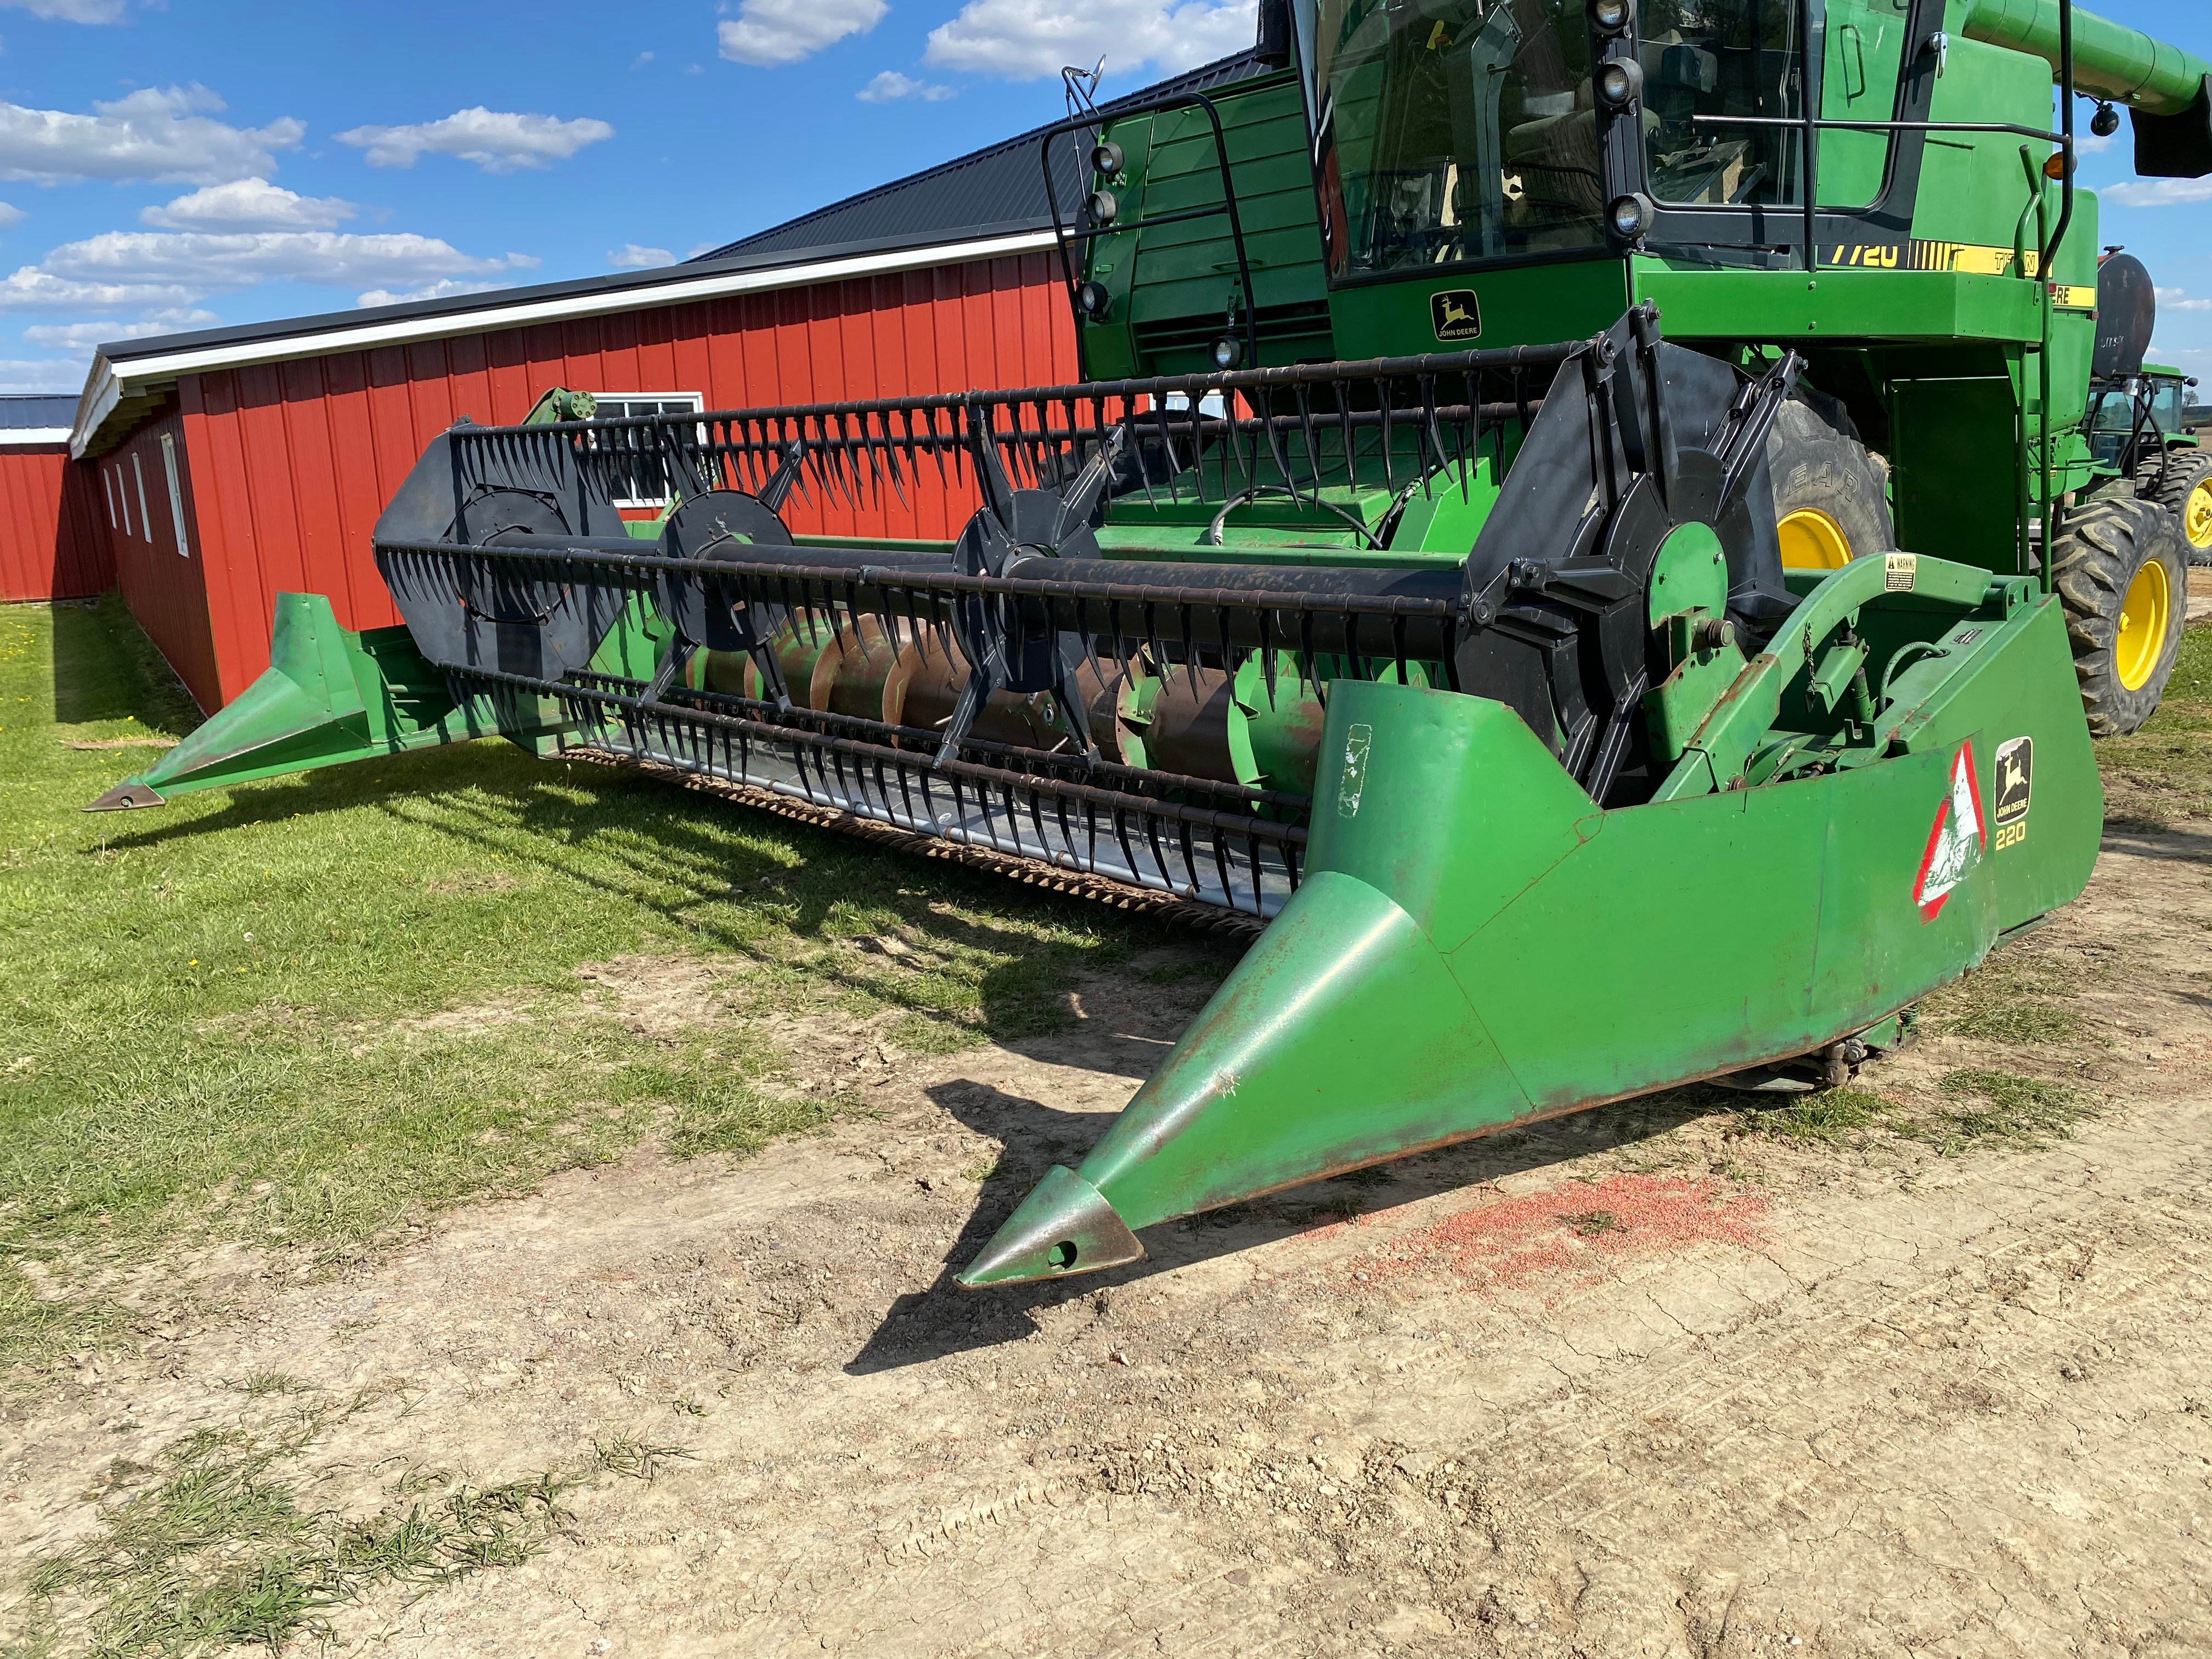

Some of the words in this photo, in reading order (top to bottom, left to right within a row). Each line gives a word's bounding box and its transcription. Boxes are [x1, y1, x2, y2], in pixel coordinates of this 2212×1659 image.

[1457, 327, 1478, 335] DEERE
[1996, 805, 2011, 818] JOHN
[2011, 798, 2027, 811] DEERE
[1995, 821, 2026, 851] 220
